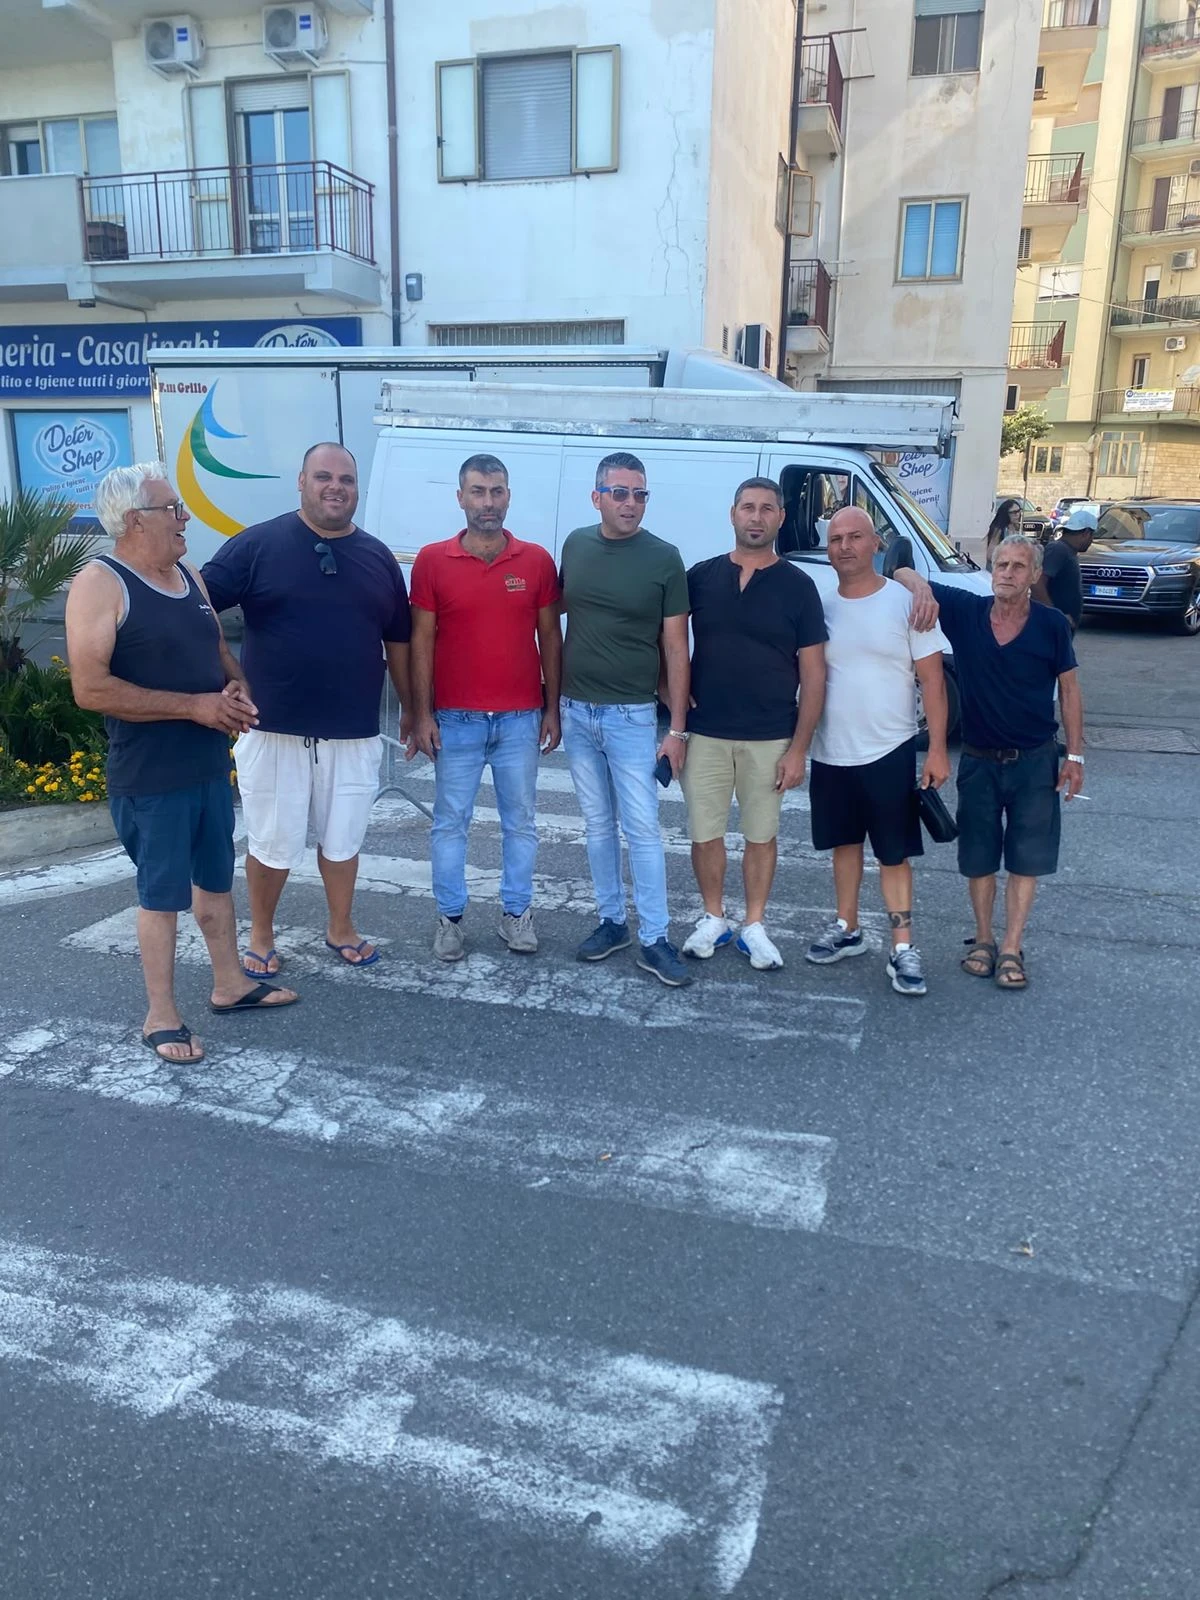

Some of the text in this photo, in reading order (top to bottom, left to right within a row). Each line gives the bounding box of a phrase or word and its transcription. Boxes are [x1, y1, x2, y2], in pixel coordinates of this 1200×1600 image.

[25, 377, 32, 387] e
[35, 374, 75, 390] Igiene
[78, 374, 106, 387] tutti
[109, 374, 113, 387] i
[177, 382, 208, 394] Grillo
[44, 424, 94, 453] Deter
[62, 449, 105, 473] Shop
[899, 462, 934, 478] Shop
